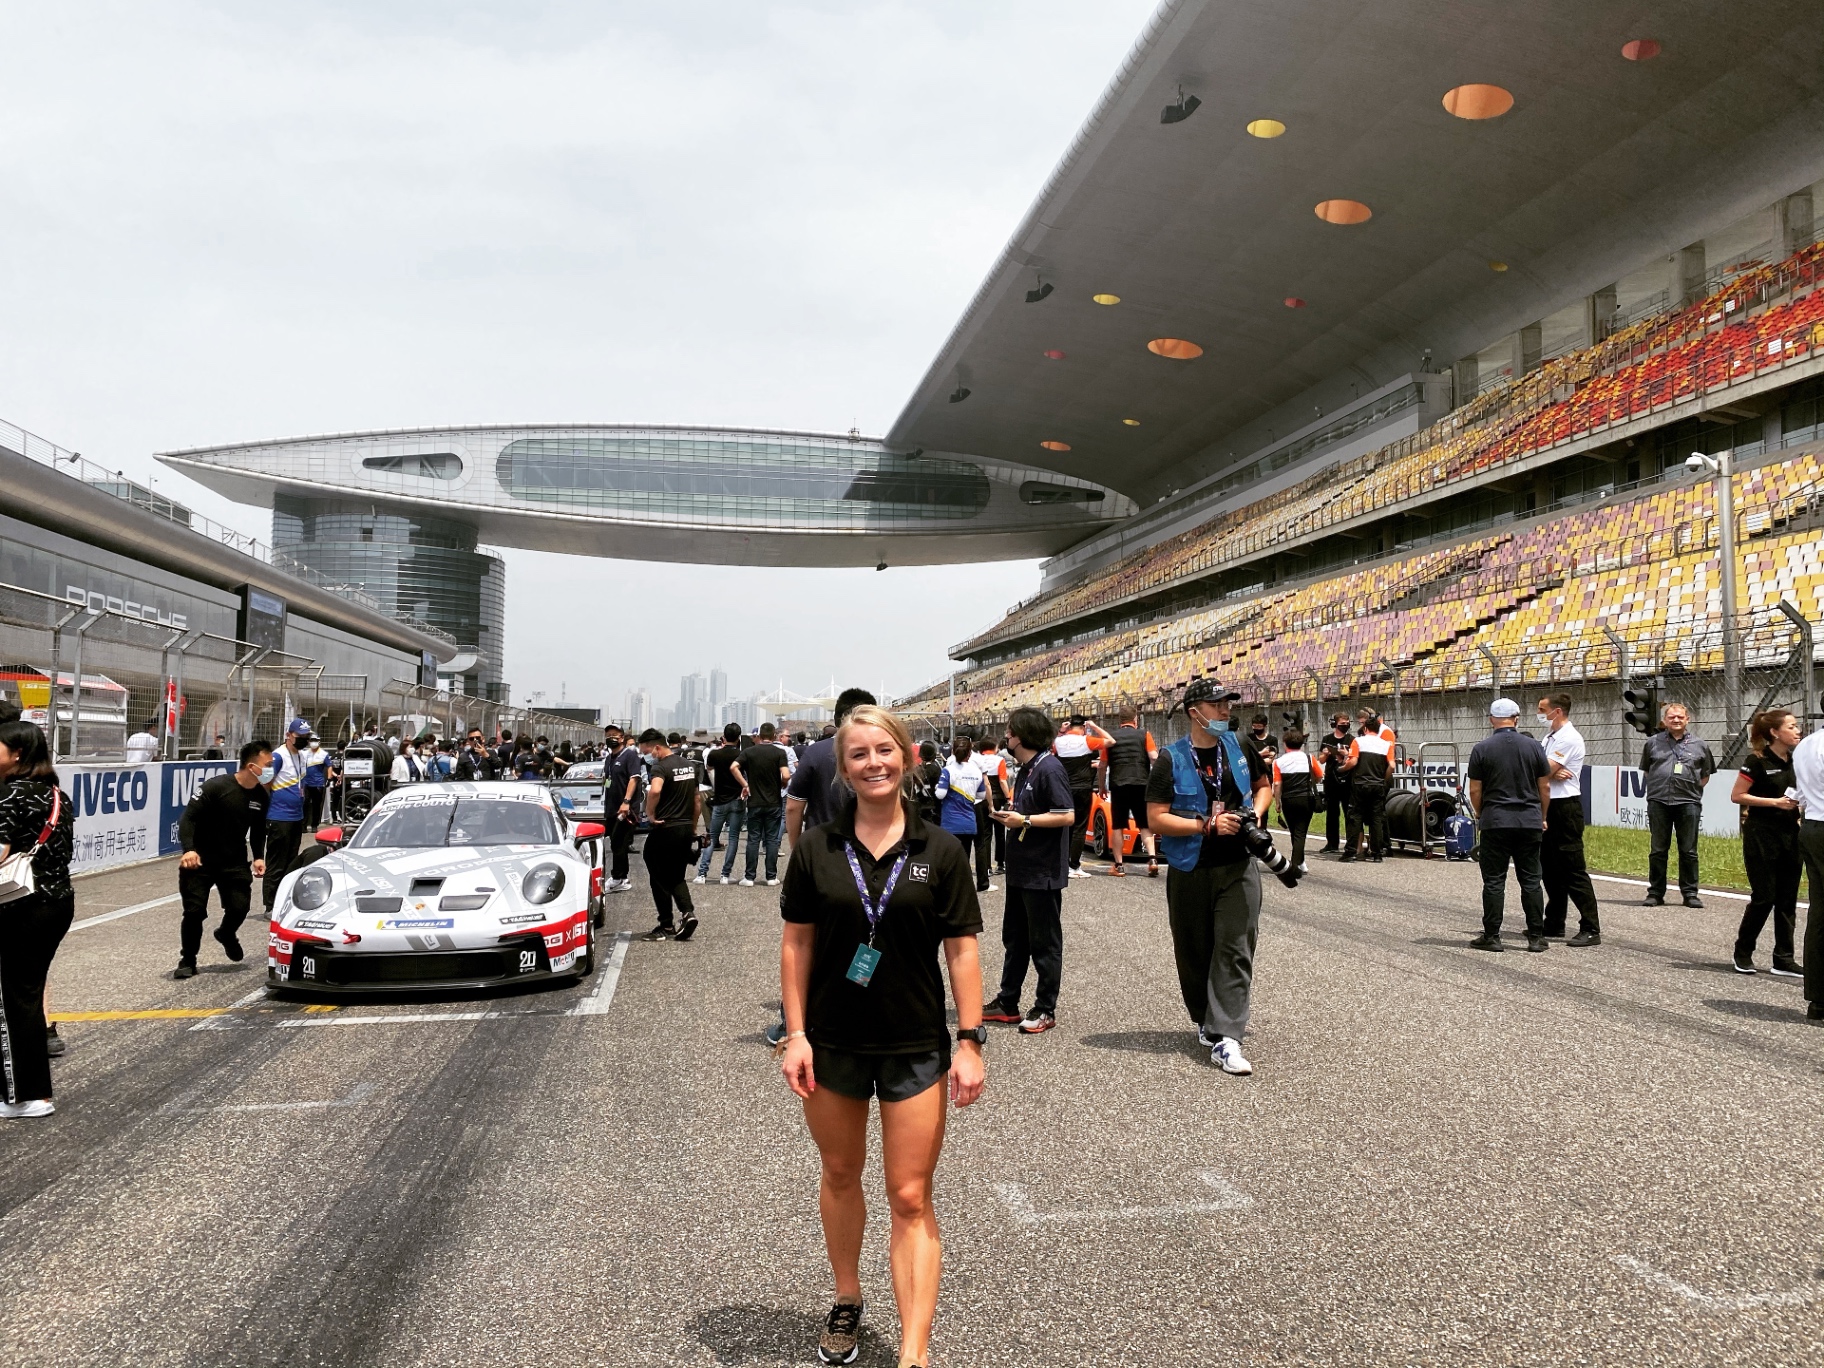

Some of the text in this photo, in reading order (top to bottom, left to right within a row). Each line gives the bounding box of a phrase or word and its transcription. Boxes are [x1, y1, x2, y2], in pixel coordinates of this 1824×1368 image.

[66, 585, 188, 629] PORSCHE
[72, 770, 149, 818] IVECO
[382, 792, 543, 806] PORSCHE
[413, 799, 455, 809] COUTO
[912, 865, 927, 877] tc
[302, 956, 315, 975] 20
[519, 950, 537, 968] 20
